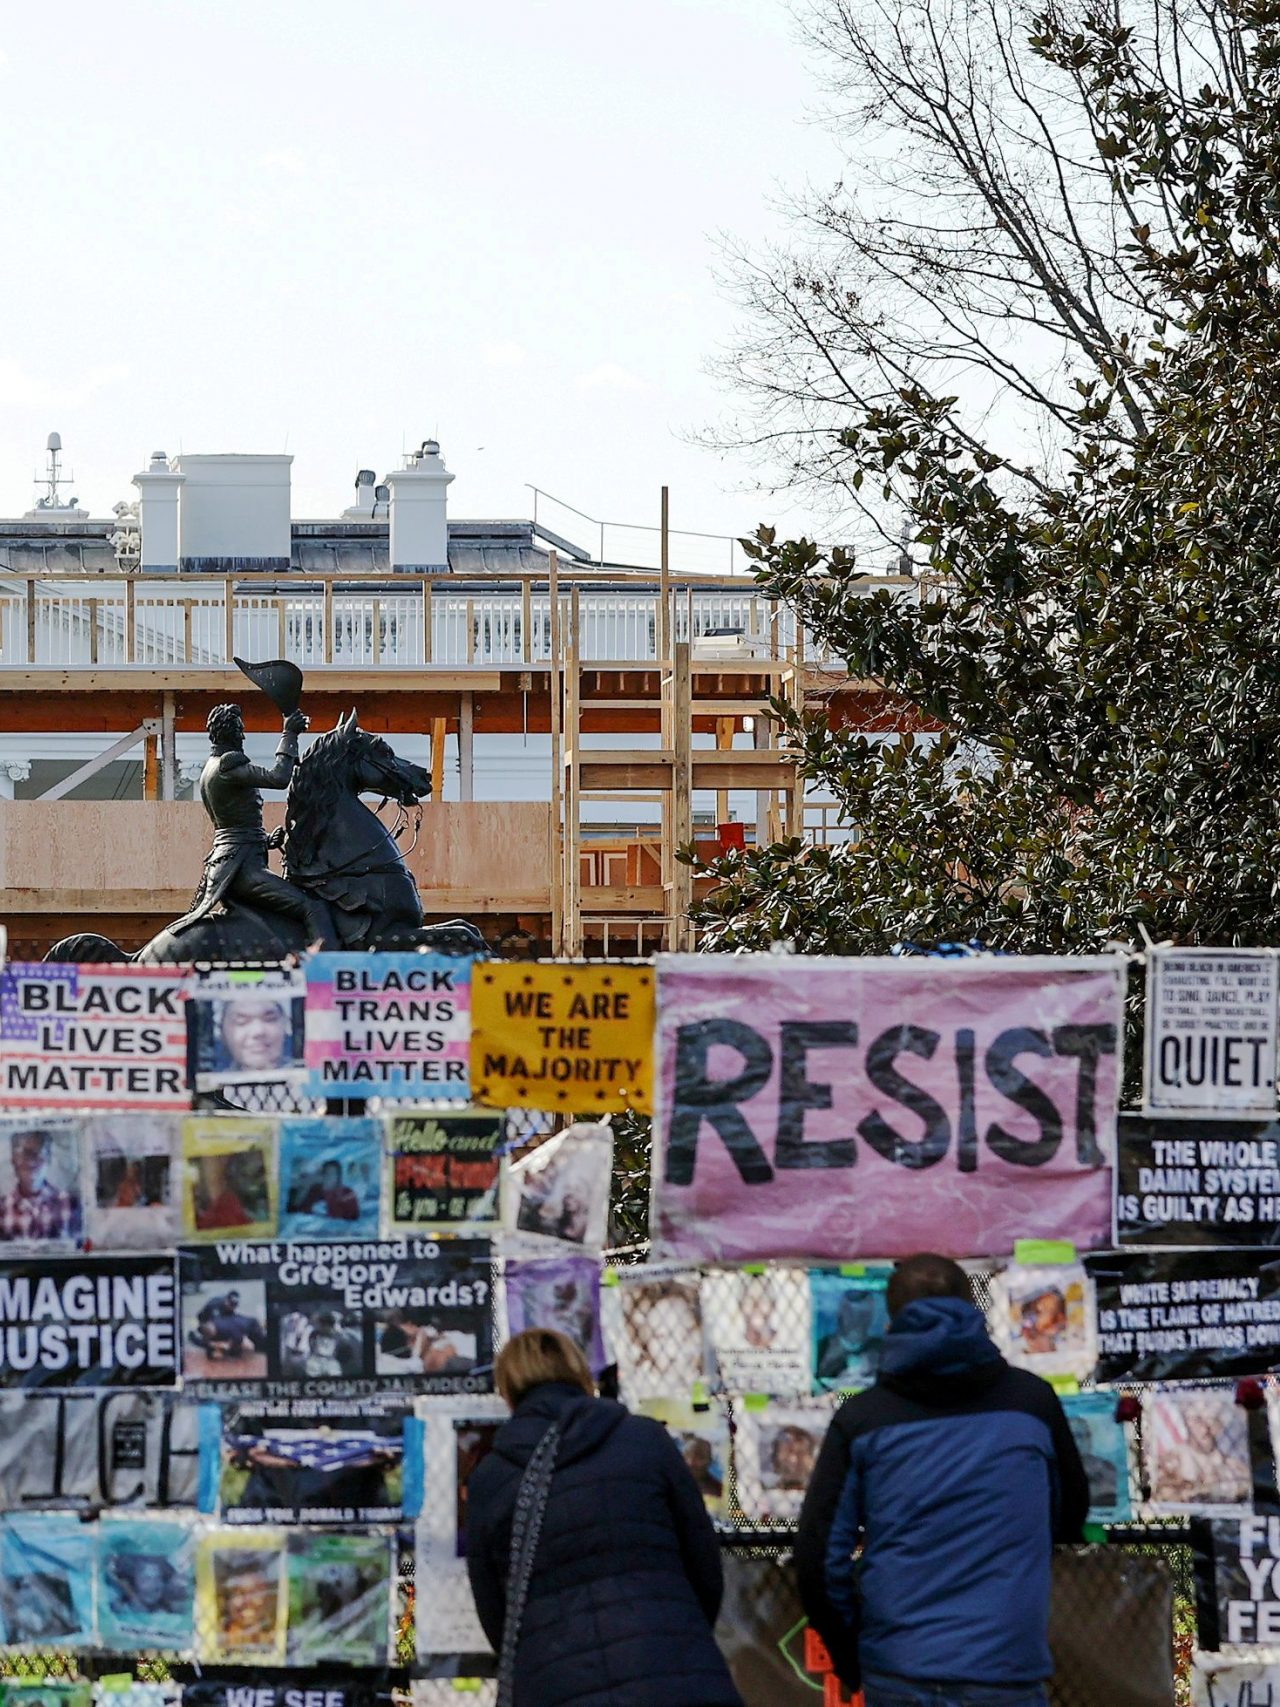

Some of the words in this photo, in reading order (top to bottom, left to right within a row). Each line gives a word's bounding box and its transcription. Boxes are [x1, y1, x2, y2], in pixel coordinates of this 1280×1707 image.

[336, 969, 455, 992] BLACK
[23, 984, 177, 1014] BLACK
[336, 1000, 454, 1022] TRANS
[504, 993, 554, 1019] WE
[567, 992, 630, 1020] ARE
[43, 1026, 163, 1053] LIVES
[345, 1030, 445, 1052] LIVES
[538, 1026, 591, 1050] THE
[323, 1060, 466, 1083] MATTER
[483, 1053, 642, 1083] MAJORITY
[1161, 1035, 1273, 1088] QUIET.
[8, 1065, 181, 1093] MATTER
[665, 1018, 1118, 1186] RESIST
[1152, 1140, 1197, 1166] THE
[1199, 1140, 1278, 1168] WHOLE
[1139, 1168, 1200, 1193] DAMN
[1119, 1195, 1139, 1221] IS
[1142, 1196, 1220, 1223] GUILTY
[1223, 1196, 1255, 1222] AS
[216, 1244, 280, 1265] What
[287, 1242, 408, 1266] happened
[413, 1240, 440, 1260] to
[278, 1262, 399, 1290] Gregory
[344, 1280, 489, 1309] Edwards?
[1120, 1283, 1170, 1306] WHITE
[1171, 1277, 1260, 1301] SUPREMACY
[269, 1379, 300, 1396] THE
[225, 1687, 275, 1707] WE
[284, 1689, 345, 1707] SEE
